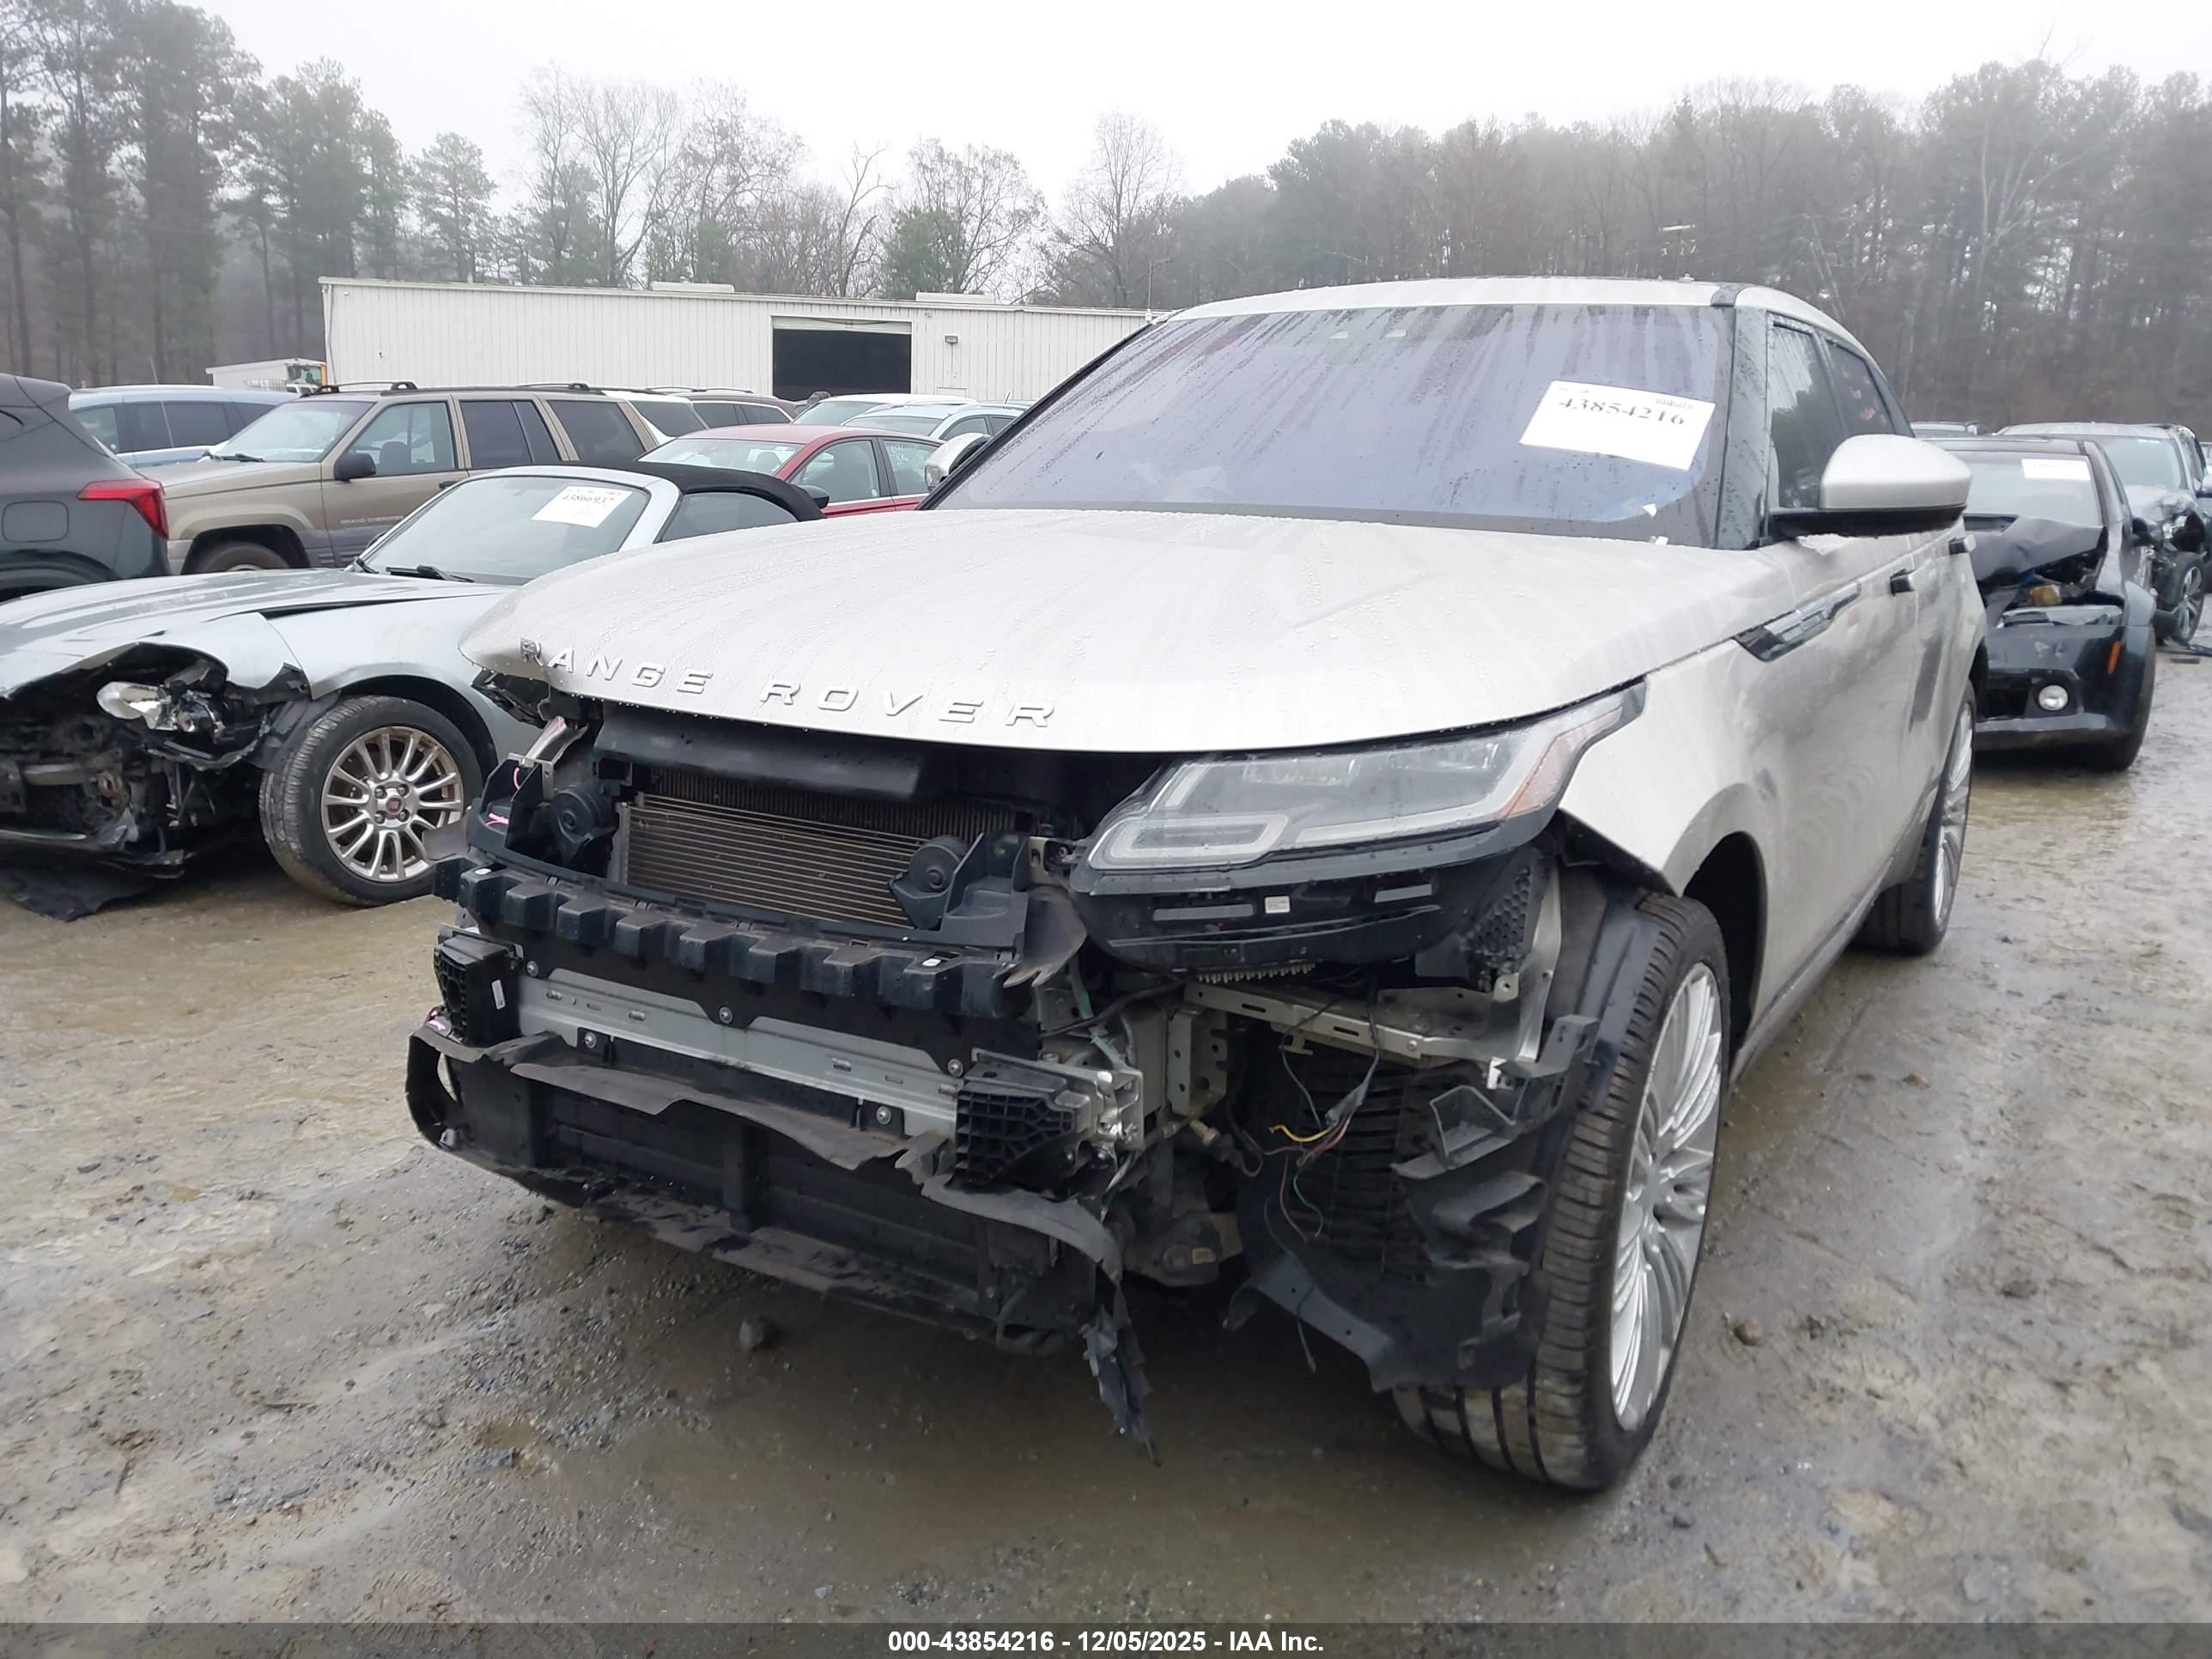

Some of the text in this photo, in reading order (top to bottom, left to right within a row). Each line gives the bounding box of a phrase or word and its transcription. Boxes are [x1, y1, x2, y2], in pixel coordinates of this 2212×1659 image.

[1559, 398, 1685, 425] 43854216
[520, 637, 1055, 727] RANGE ROVER
